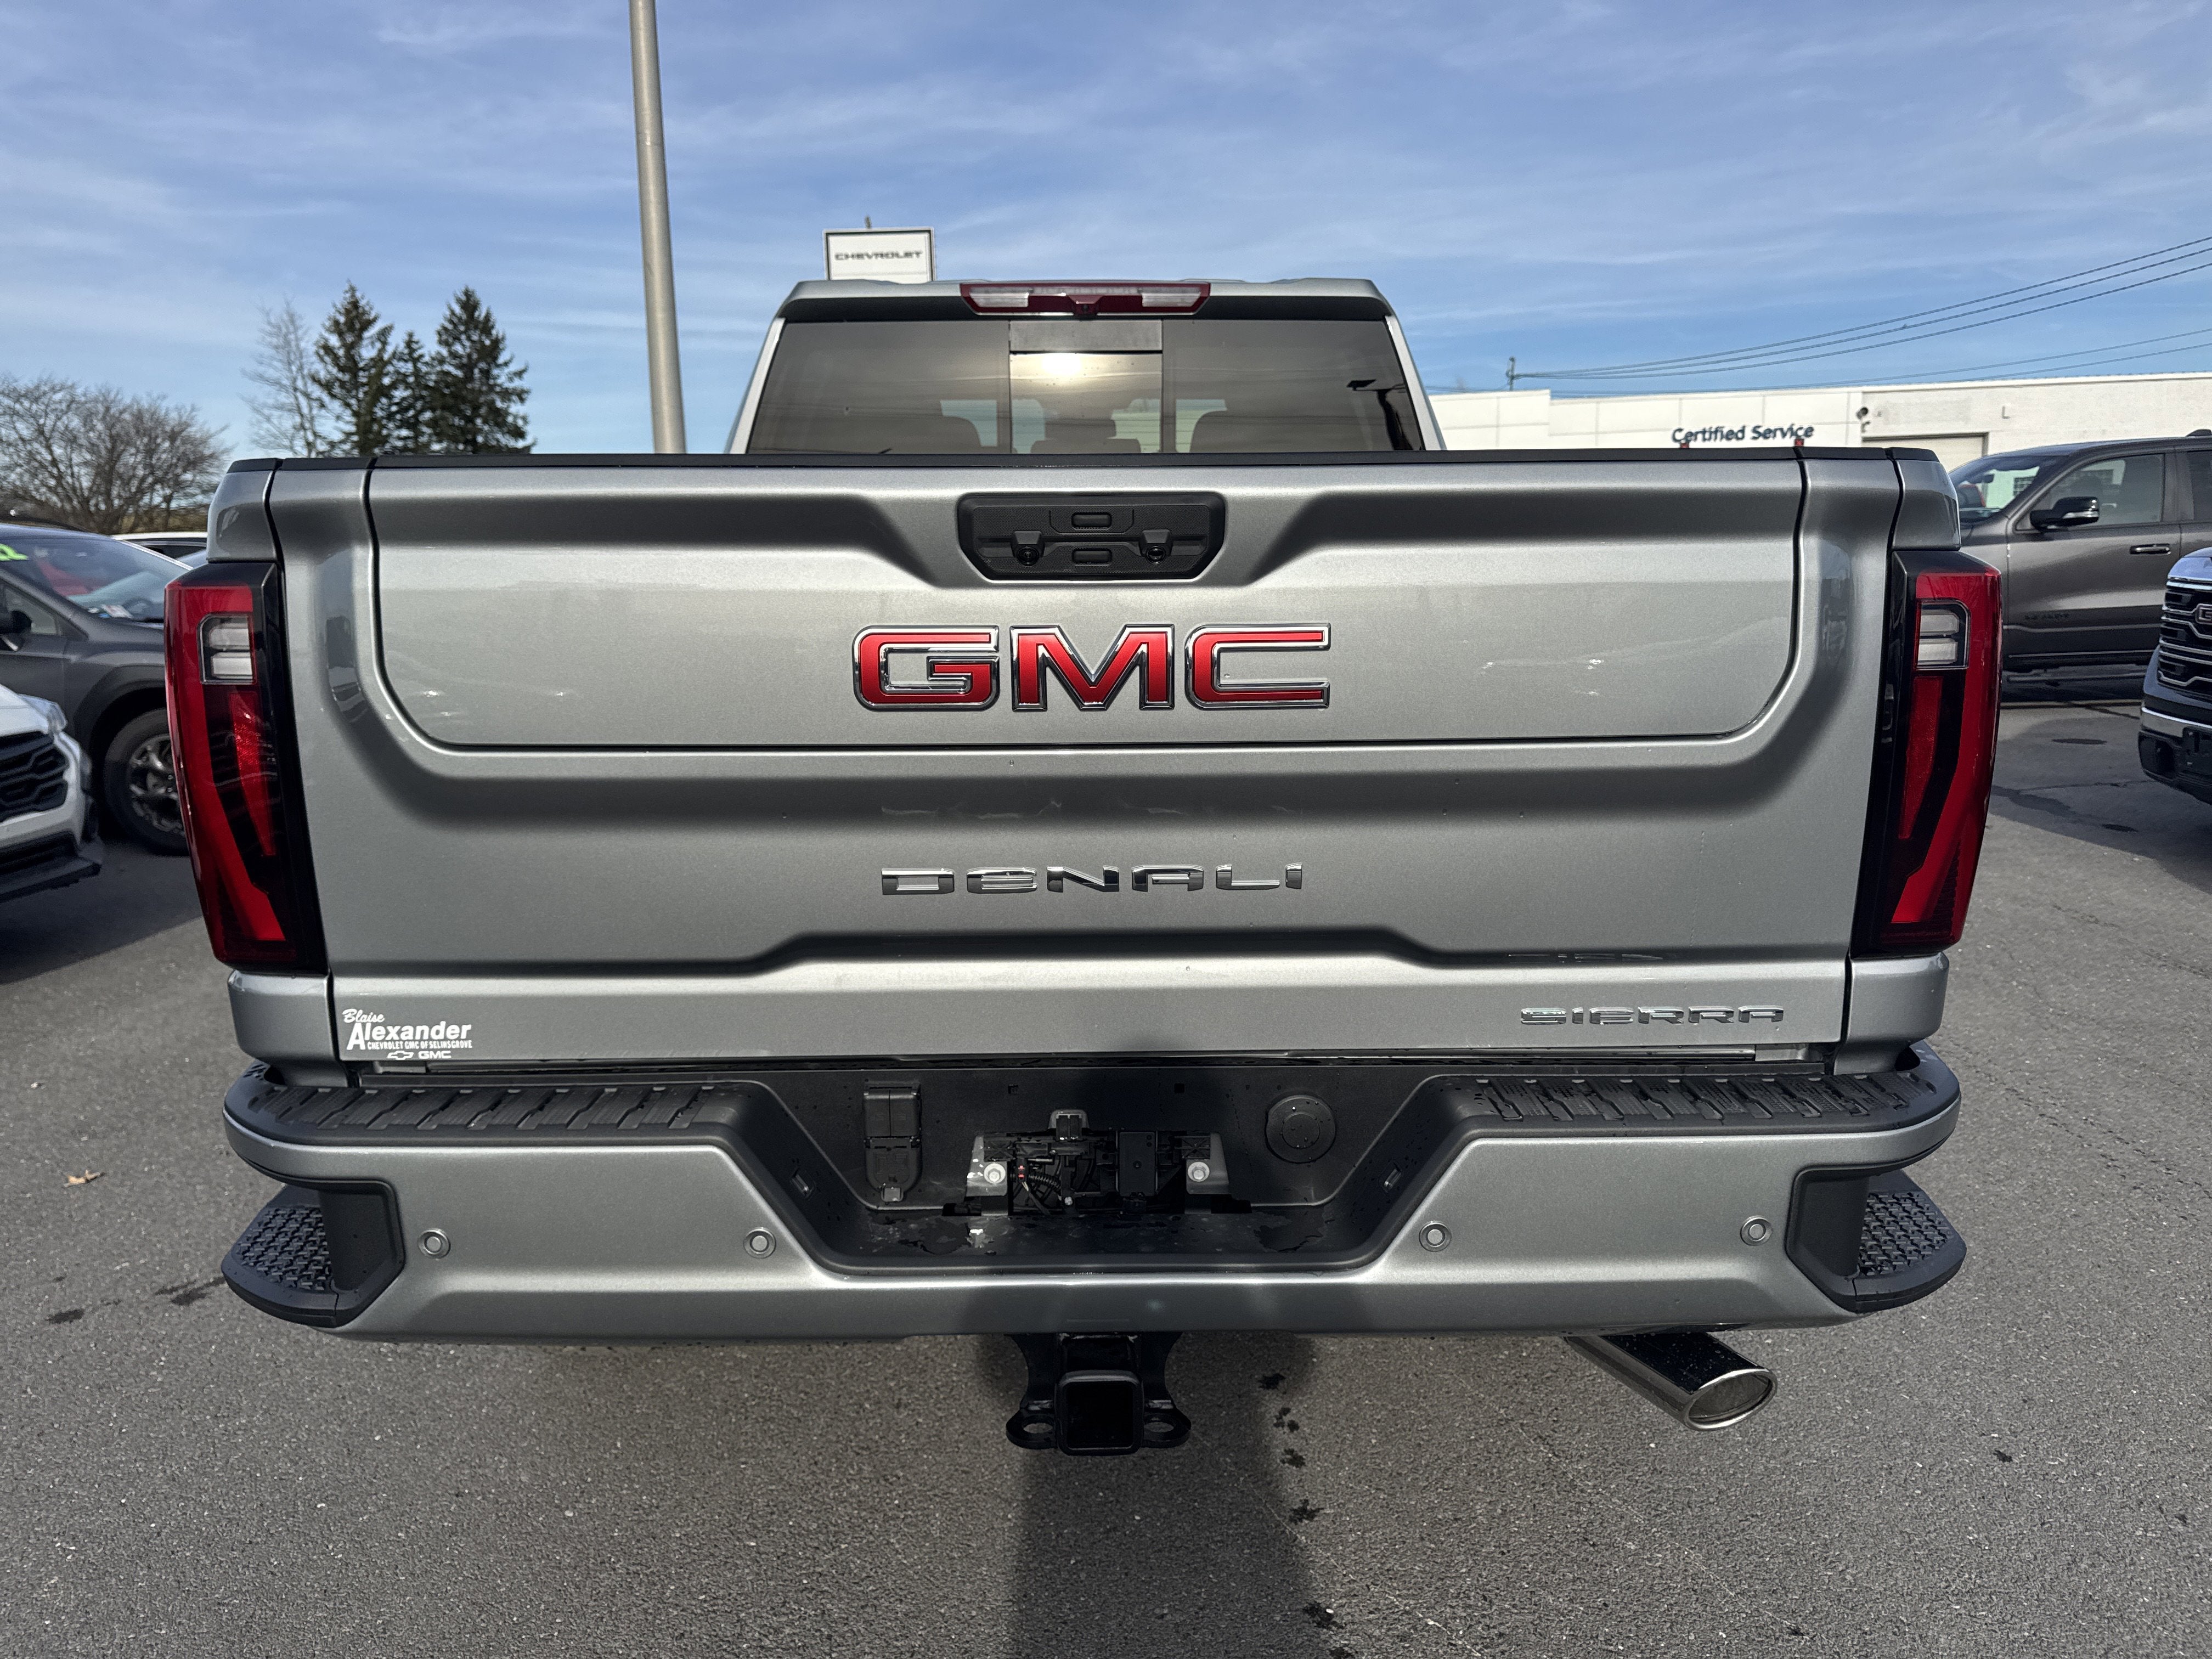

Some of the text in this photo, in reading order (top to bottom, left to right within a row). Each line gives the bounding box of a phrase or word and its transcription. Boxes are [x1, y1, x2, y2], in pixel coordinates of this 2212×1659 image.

[834, 250, 923, 260] CHEVROLET
[1671, 422, 1815, 443] Certified Service
[852, 623, 1331, 712] GMC
[881, 862, 1302, 895] DENALI
[342, 1008, 385, 1023] Blaise
[1521, 1005, 1784, 1025] SIERRA
[346, 1020, 472, 1050] Alexander
[367, 1040, 473, 1050] CHEVROLET GMC OF SELINSGROVE
[418, 1050, 452, 1059] GMC
